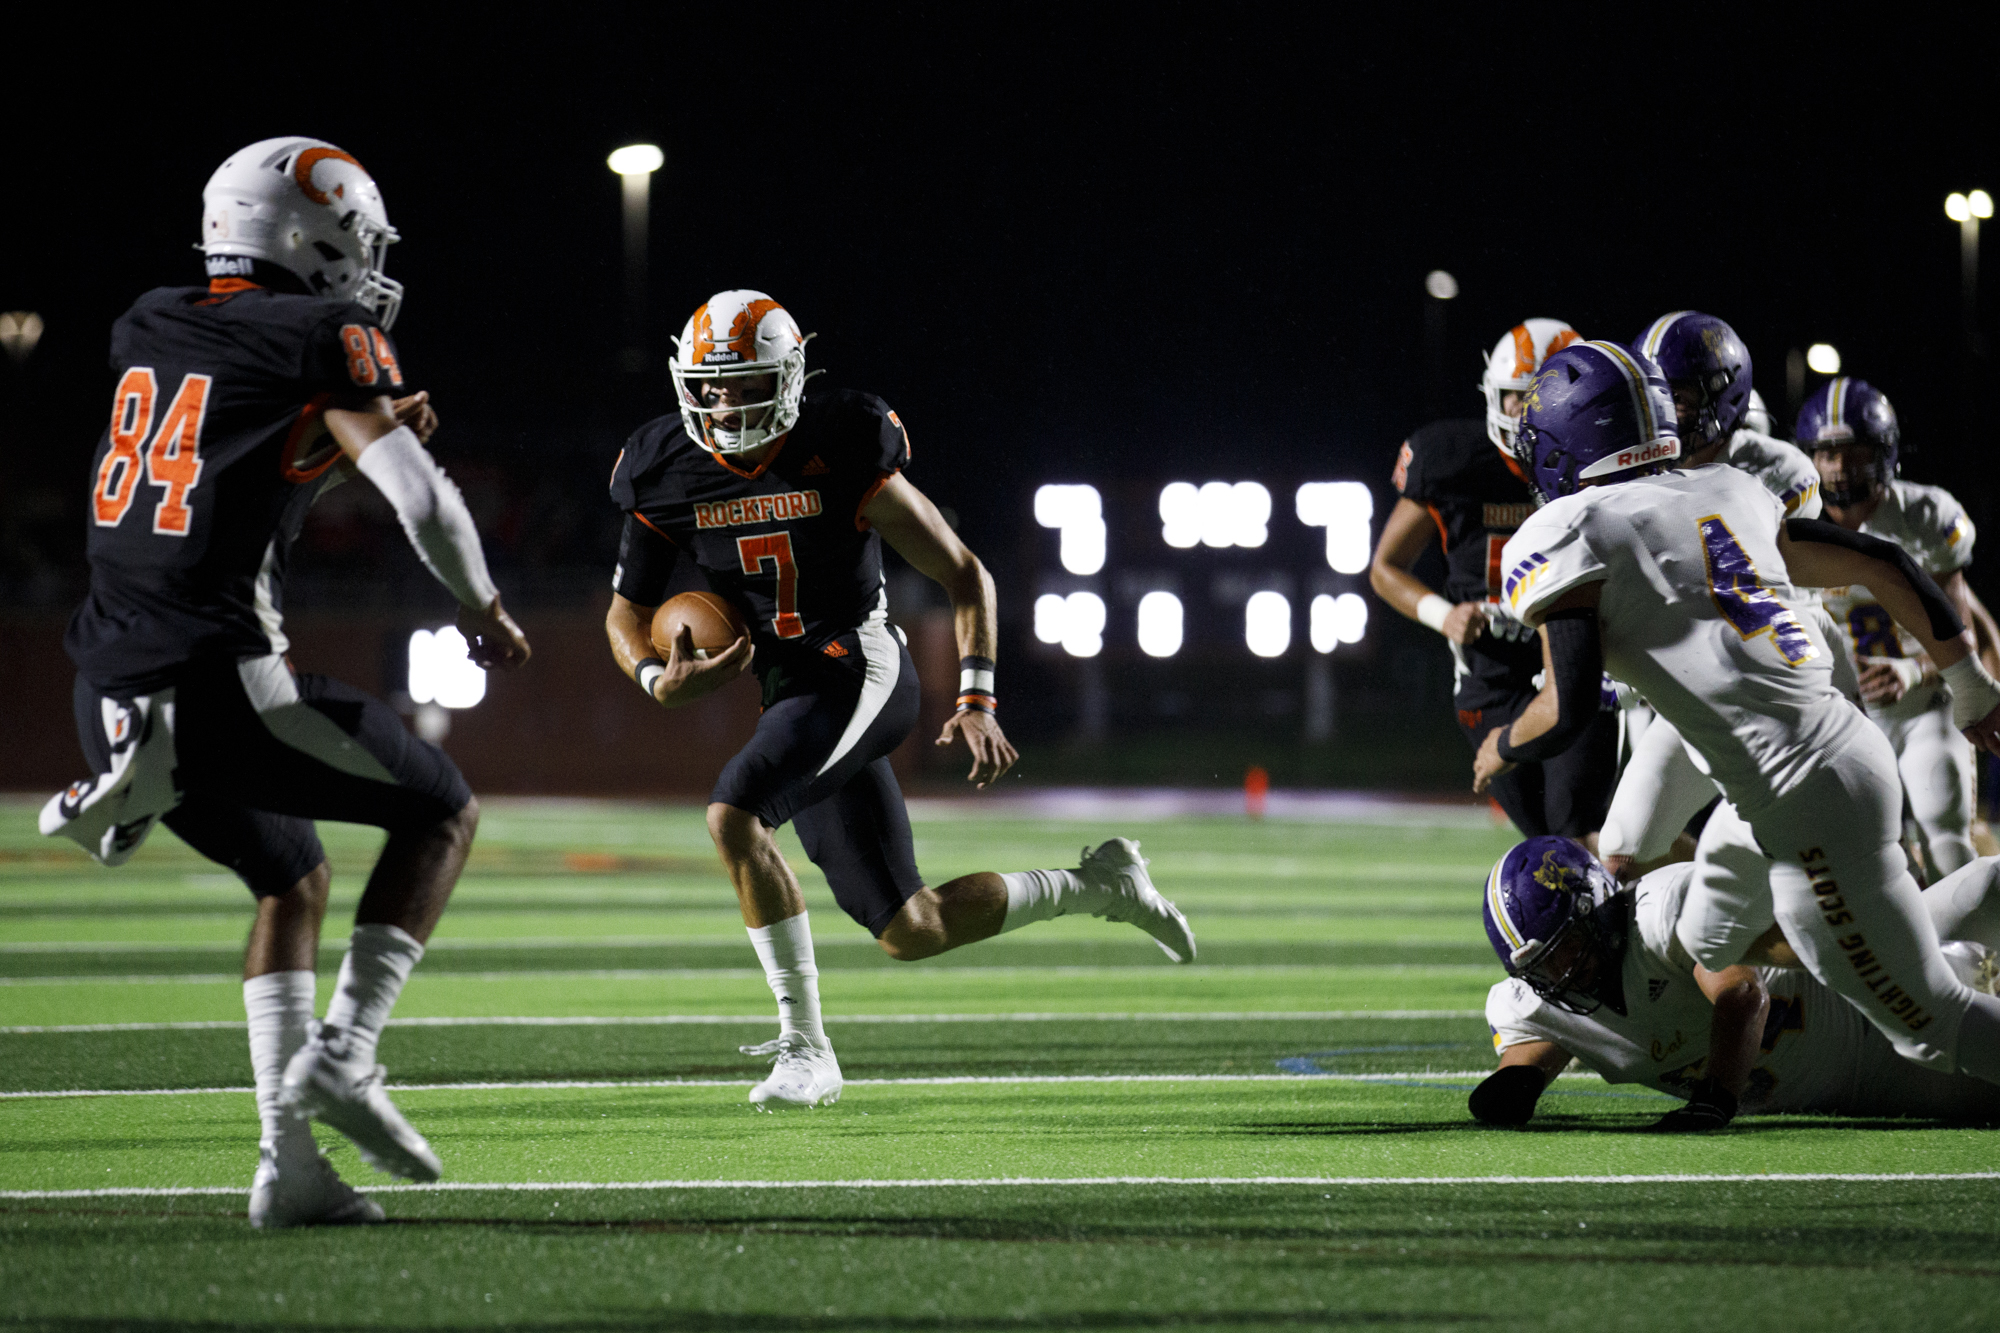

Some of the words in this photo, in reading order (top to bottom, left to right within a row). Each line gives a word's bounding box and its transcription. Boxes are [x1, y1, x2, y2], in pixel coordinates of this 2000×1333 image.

[340, 324, 403, 386] 84
[704, 351, 739, 362] Riddell
[92, 366, 213, 537] 84
[1617, 439, 1677, 467] Riddell
[693, 489, 823, 530] ROCKFORD
[736, 530, 806, 640] 7
[1696, 514, 1821, 667] 4
[1799, 846, 1855, 927] SCOTS
[1837, 932, 1934, 1031] FIGHTING
[1651, 1029, 1687, 1063] Cal
